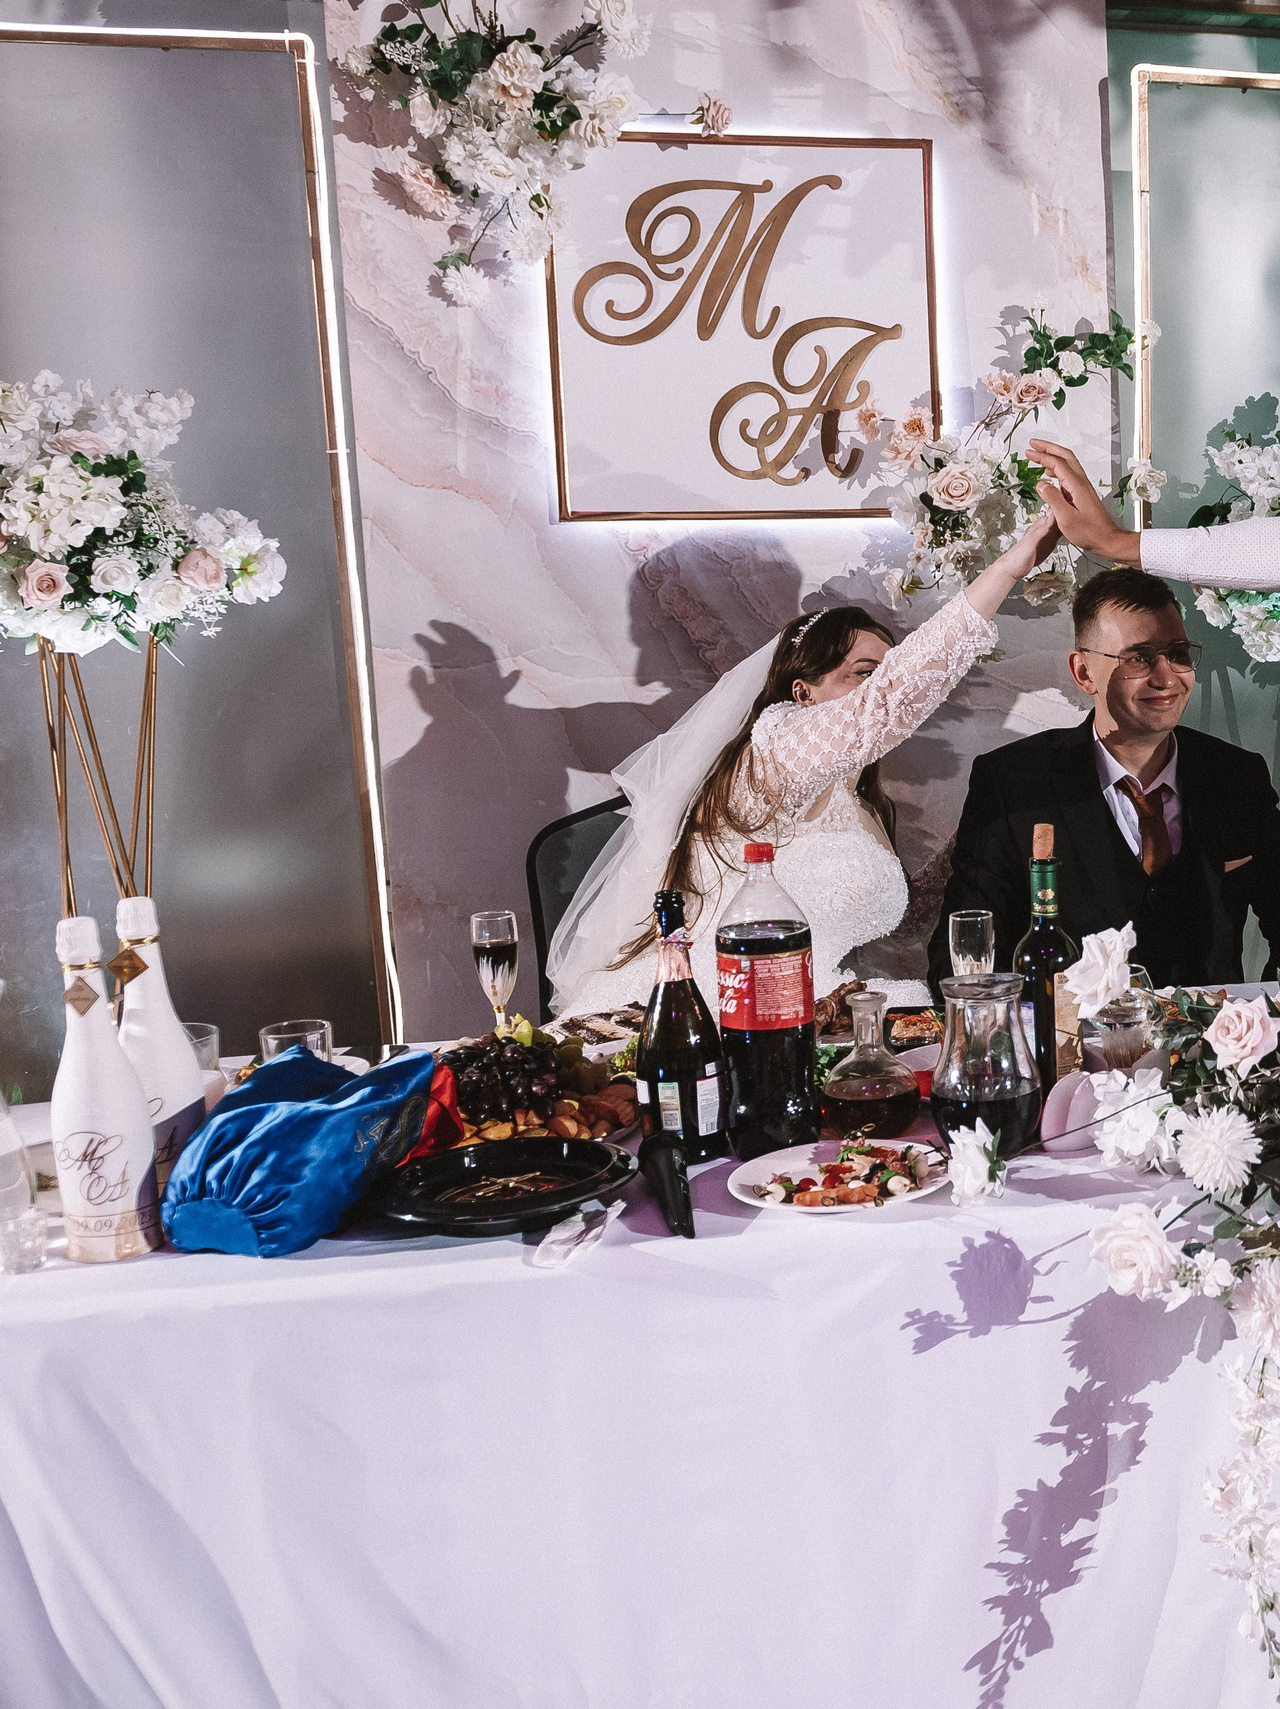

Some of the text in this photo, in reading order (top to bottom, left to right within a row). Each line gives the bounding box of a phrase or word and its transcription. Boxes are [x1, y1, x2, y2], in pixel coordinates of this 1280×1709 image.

[572, 174, 842, 346] M
[709, 316, 902, 486] A
[718, 969, 747, 989] ssic
